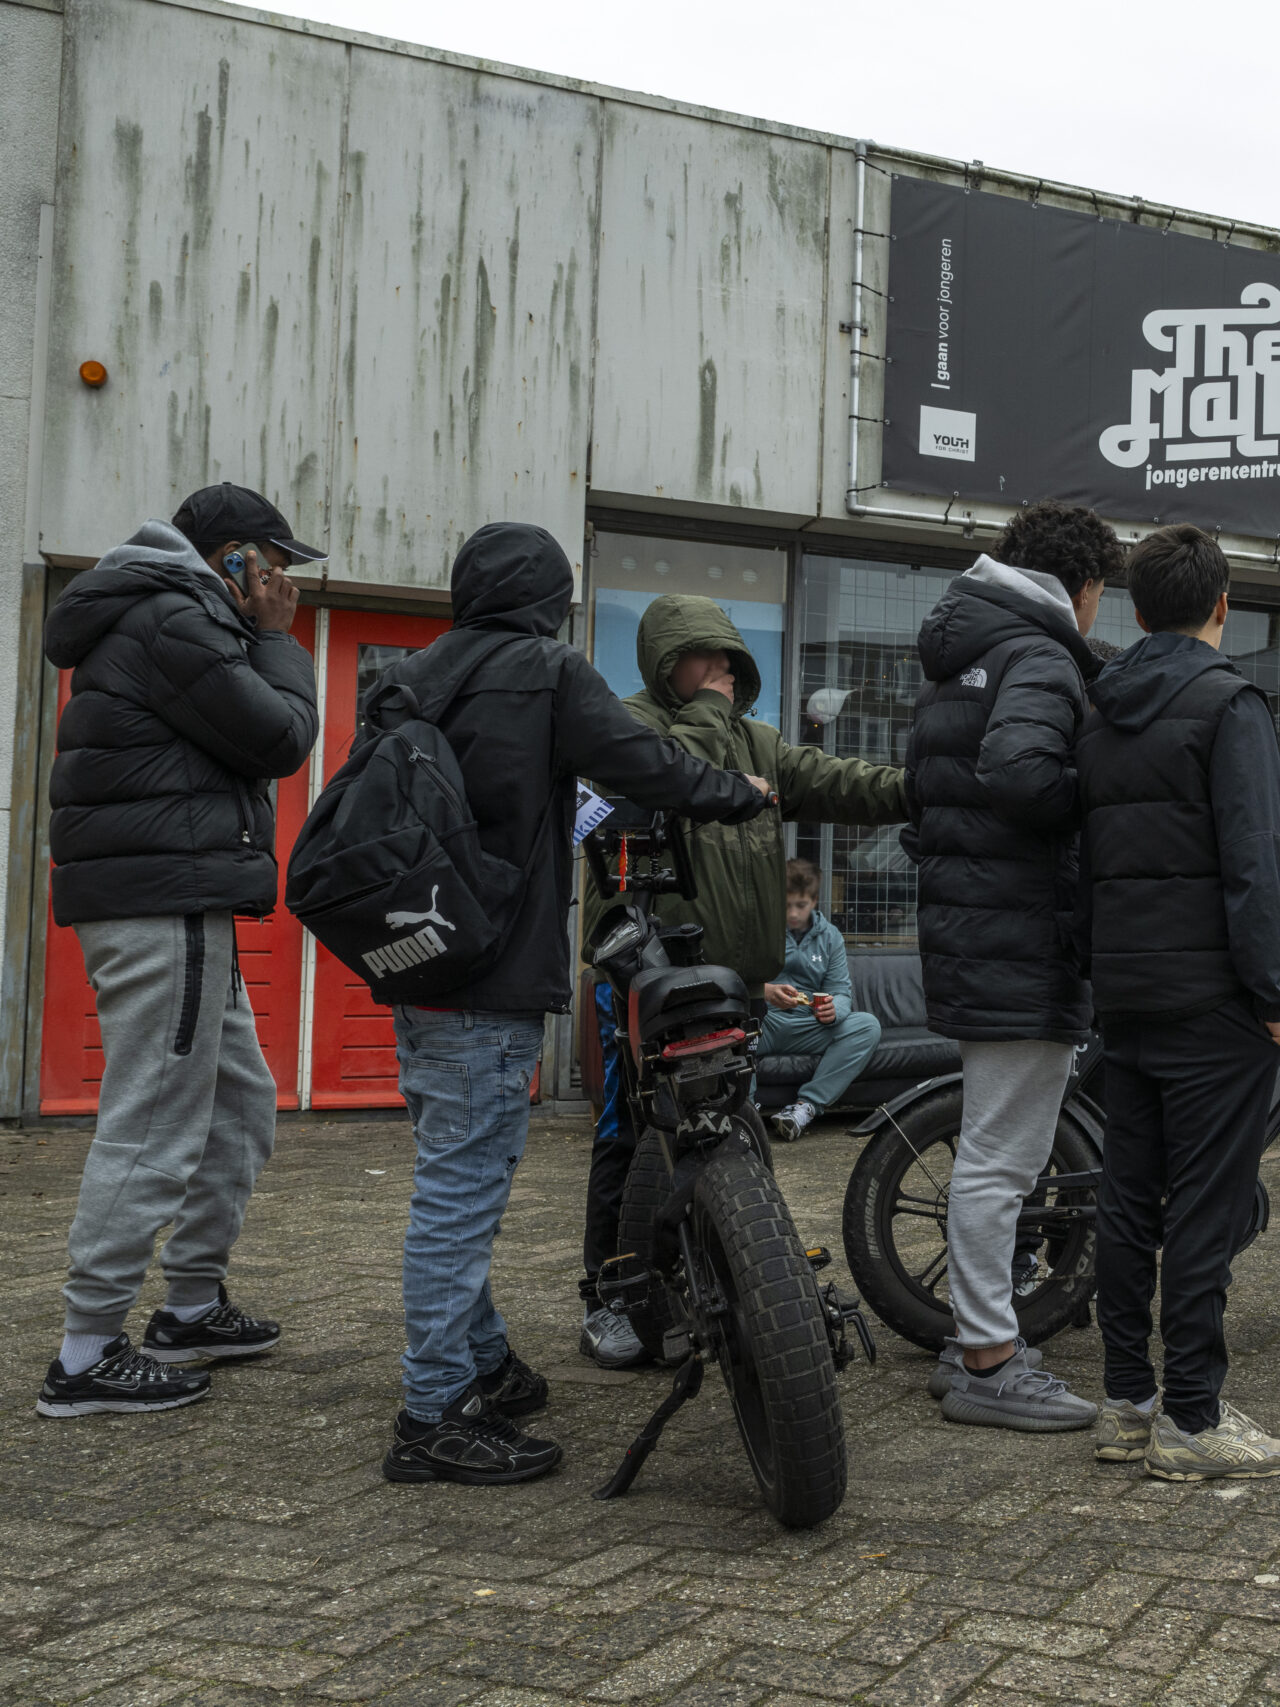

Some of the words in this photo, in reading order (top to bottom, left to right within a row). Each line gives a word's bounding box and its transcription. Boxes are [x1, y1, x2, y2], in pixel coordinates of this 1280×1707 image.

[936, 238, 954, 304] jongeren
[938, 306, 950, 338] voor
[937, 342, 950, 381] gaan
[361, 925, 448, 979] PUMA
[676, 1111, 733, 1141] AXA
